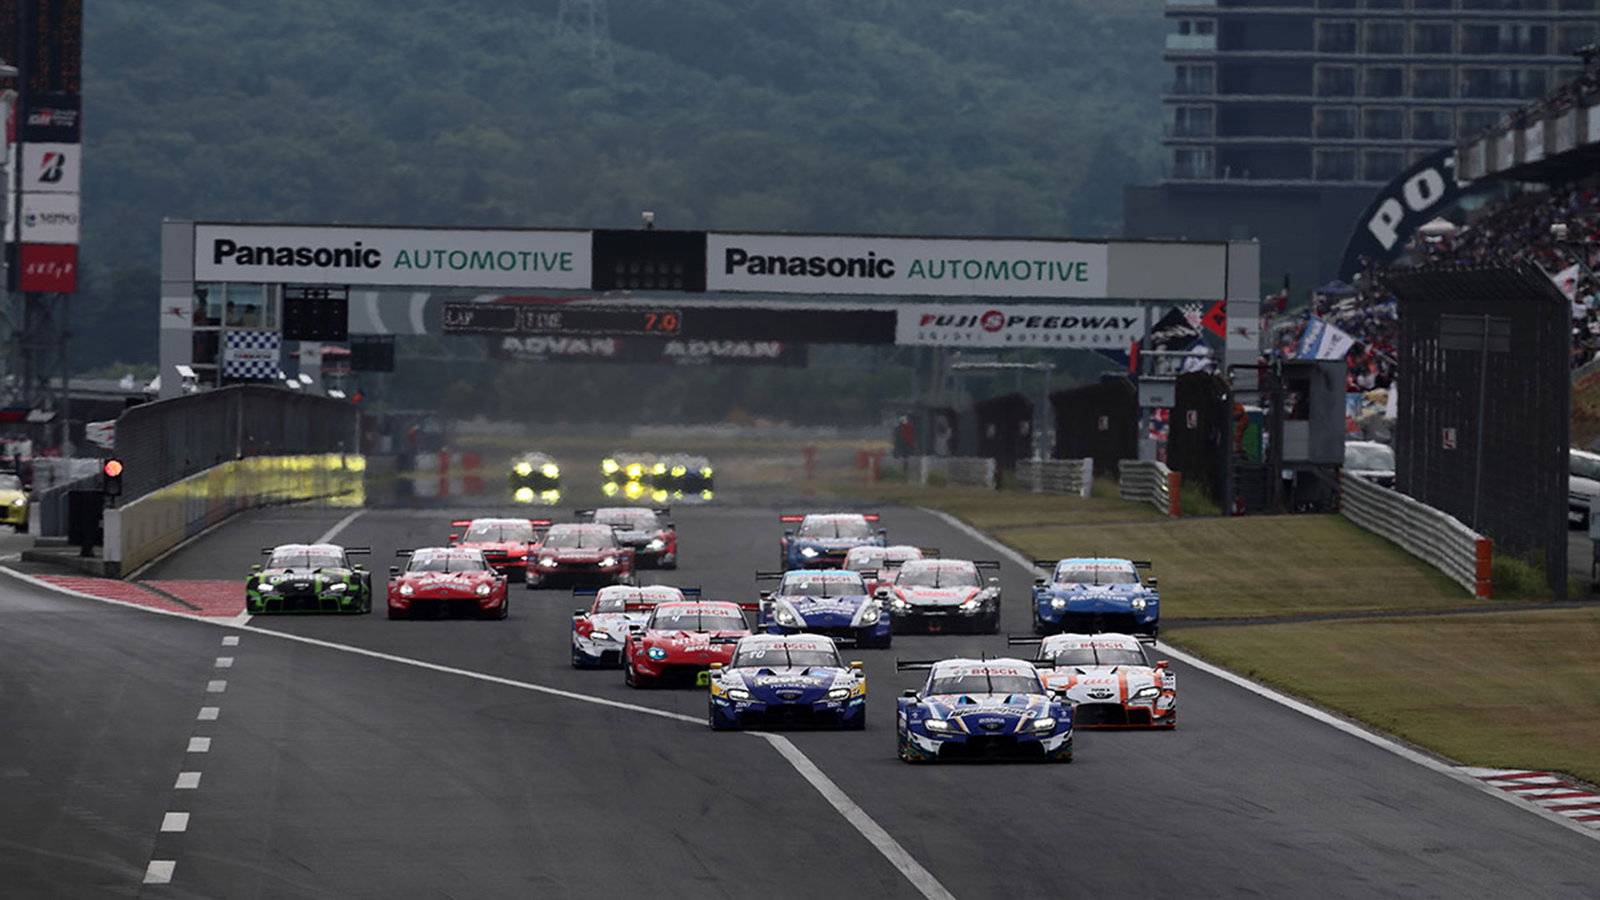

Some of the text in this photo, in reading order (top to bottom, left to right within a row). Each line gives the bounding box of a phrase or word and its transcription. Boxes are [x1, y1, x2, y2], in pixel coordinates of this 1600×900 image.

[213, 239, 573, 272] Panasonic AUTOMOTIVE
[725, 247, 1088, 282] Panasonic AUTOMOTIVE
[644, 313, 678, 331] 7.0
[919, 314, 978, 328] FUJI
[502, 337, 616, 354] ADVAN
[664, 340, 782, 358] ADVAN
[971, 668, 1018, 676] BOSCH
